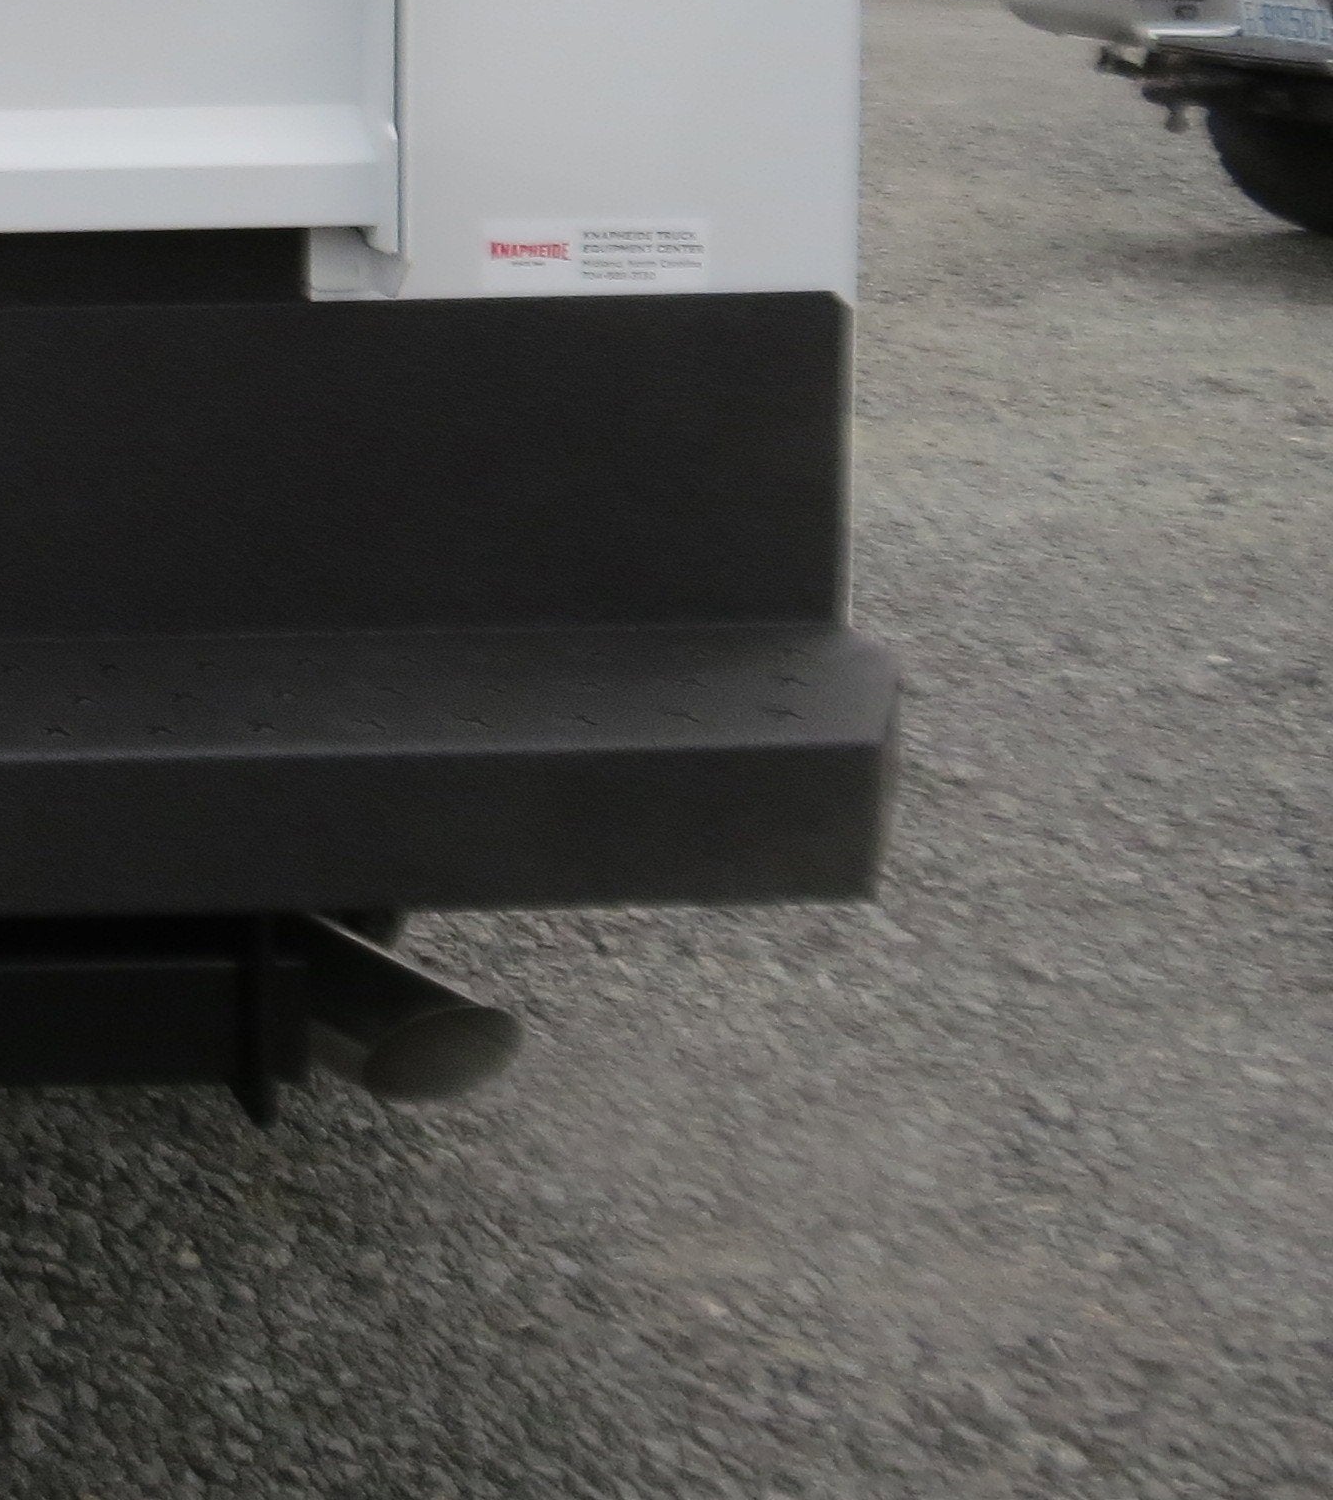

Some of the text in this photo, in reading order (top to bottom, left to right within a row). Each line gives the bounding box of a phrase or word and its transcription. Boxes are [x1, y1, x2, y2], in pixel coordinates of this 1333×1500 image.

[656, 231, 697, 241] TRUCK
[491, 241, 572, 261] KNAPHEIDE
[582, 244, 705, 254] EQUIPMENT CENTER
